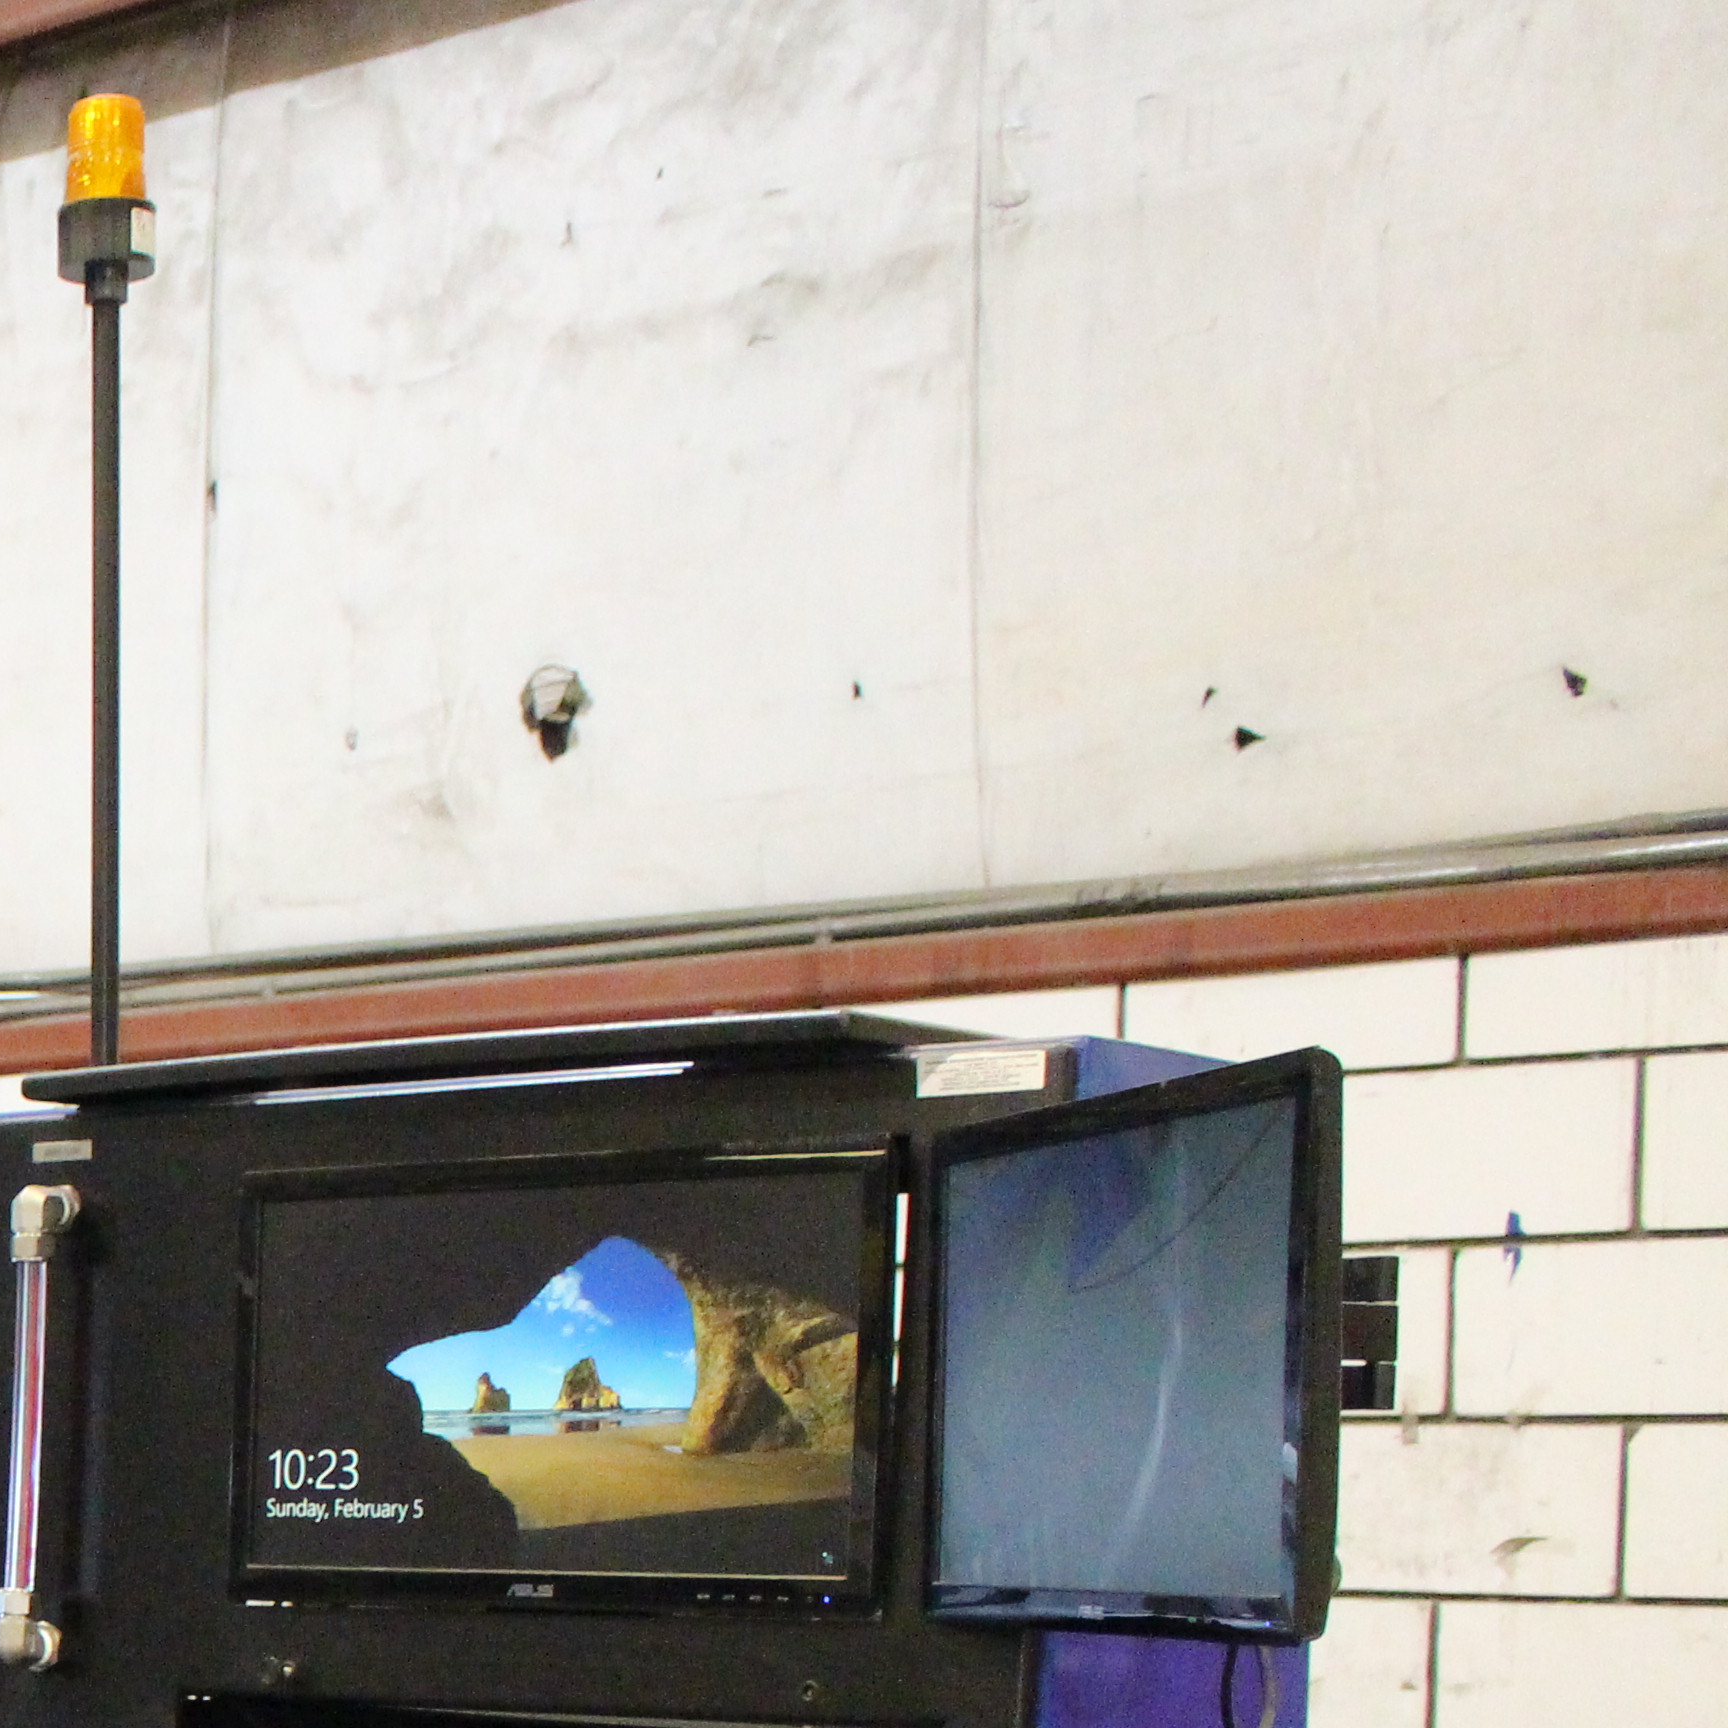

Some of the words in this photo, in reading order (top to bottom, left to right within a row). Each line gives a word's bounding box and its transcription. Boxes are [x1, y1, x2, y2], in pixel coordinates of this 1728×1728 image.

[267, 1448, 360, 1490] 10:23
[266, 1497, 329, 1522] Sunday,
[334, 1498, 409, 1524] February
[412, 1498, 425, 1519] 5
